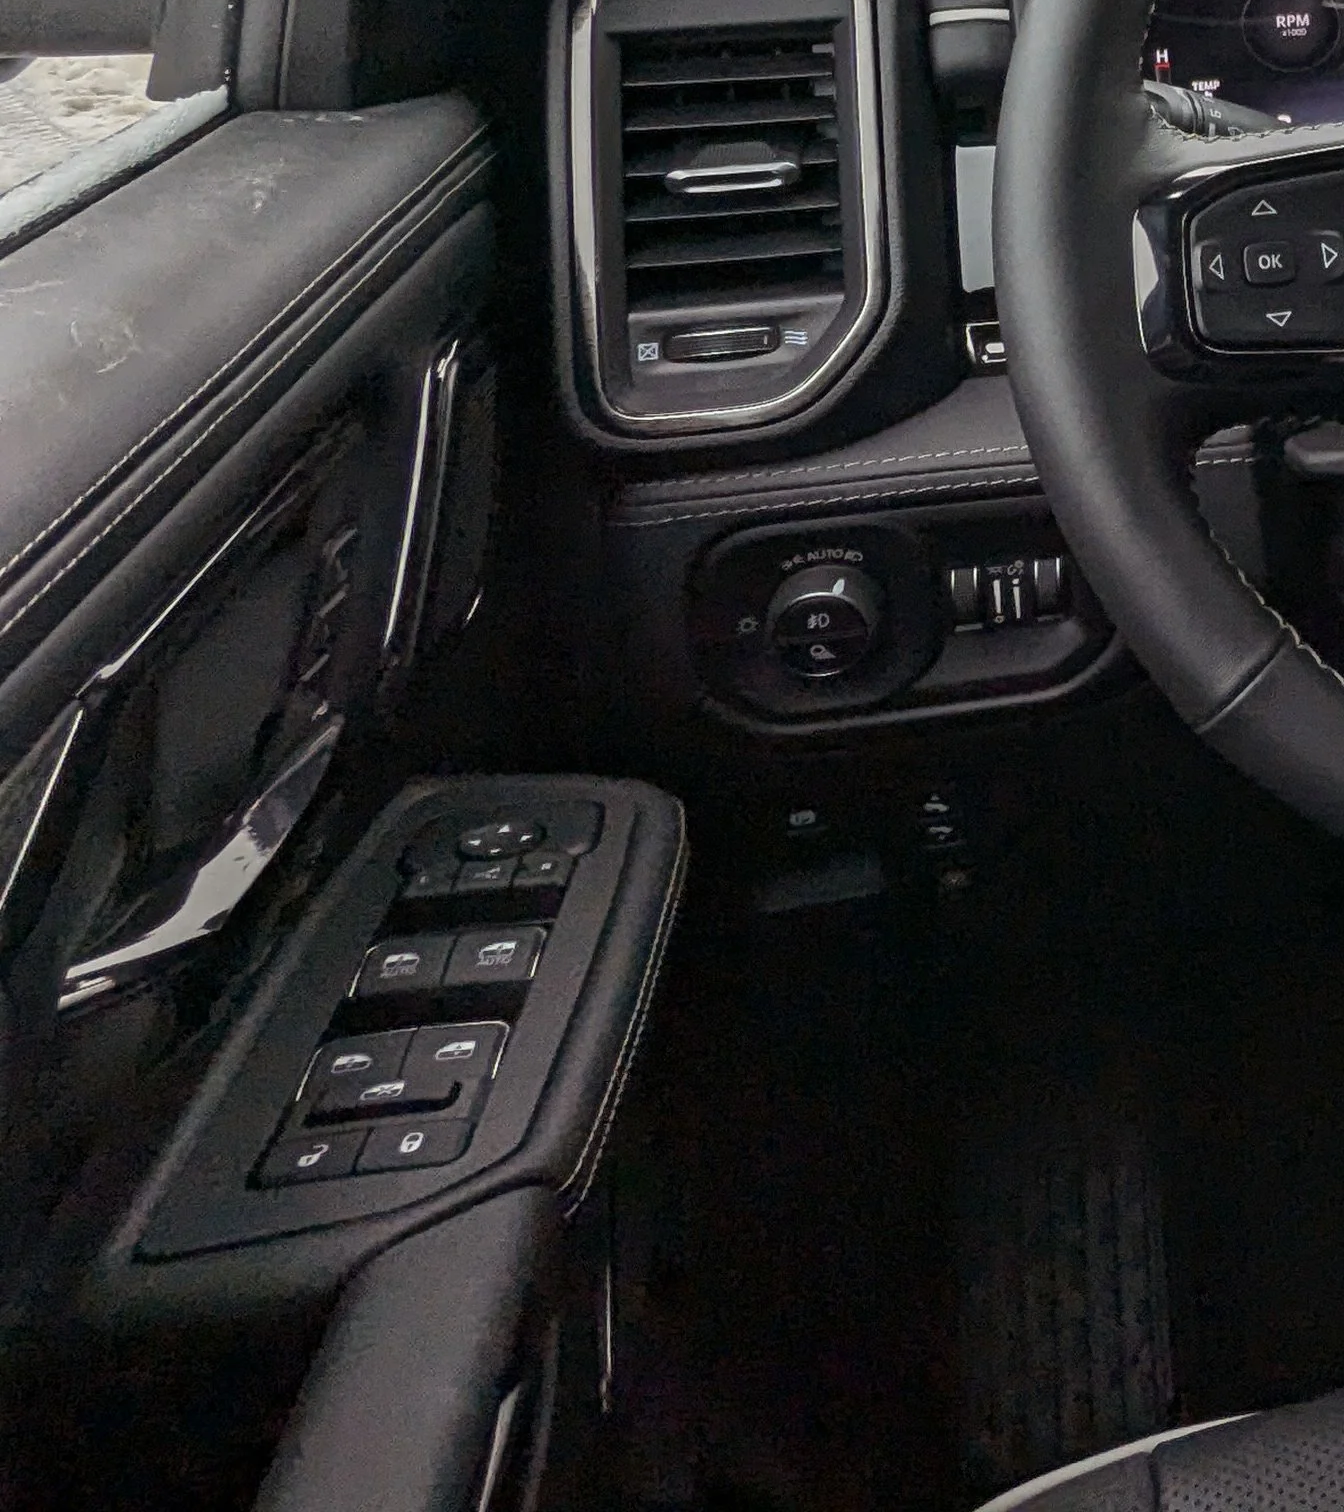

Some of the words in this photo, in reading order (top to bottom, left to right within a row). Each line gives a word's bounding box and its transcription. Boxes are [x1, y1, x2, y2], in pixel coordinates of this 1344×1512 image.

[1276, 14, 1310, 28] RPM
[1155, 49, 1169, 63] H
[1192, 80, 1221, 92] TEMP
[1258, 254, 1283, 270] OK
[807, 548, 844, 562] AUTO
